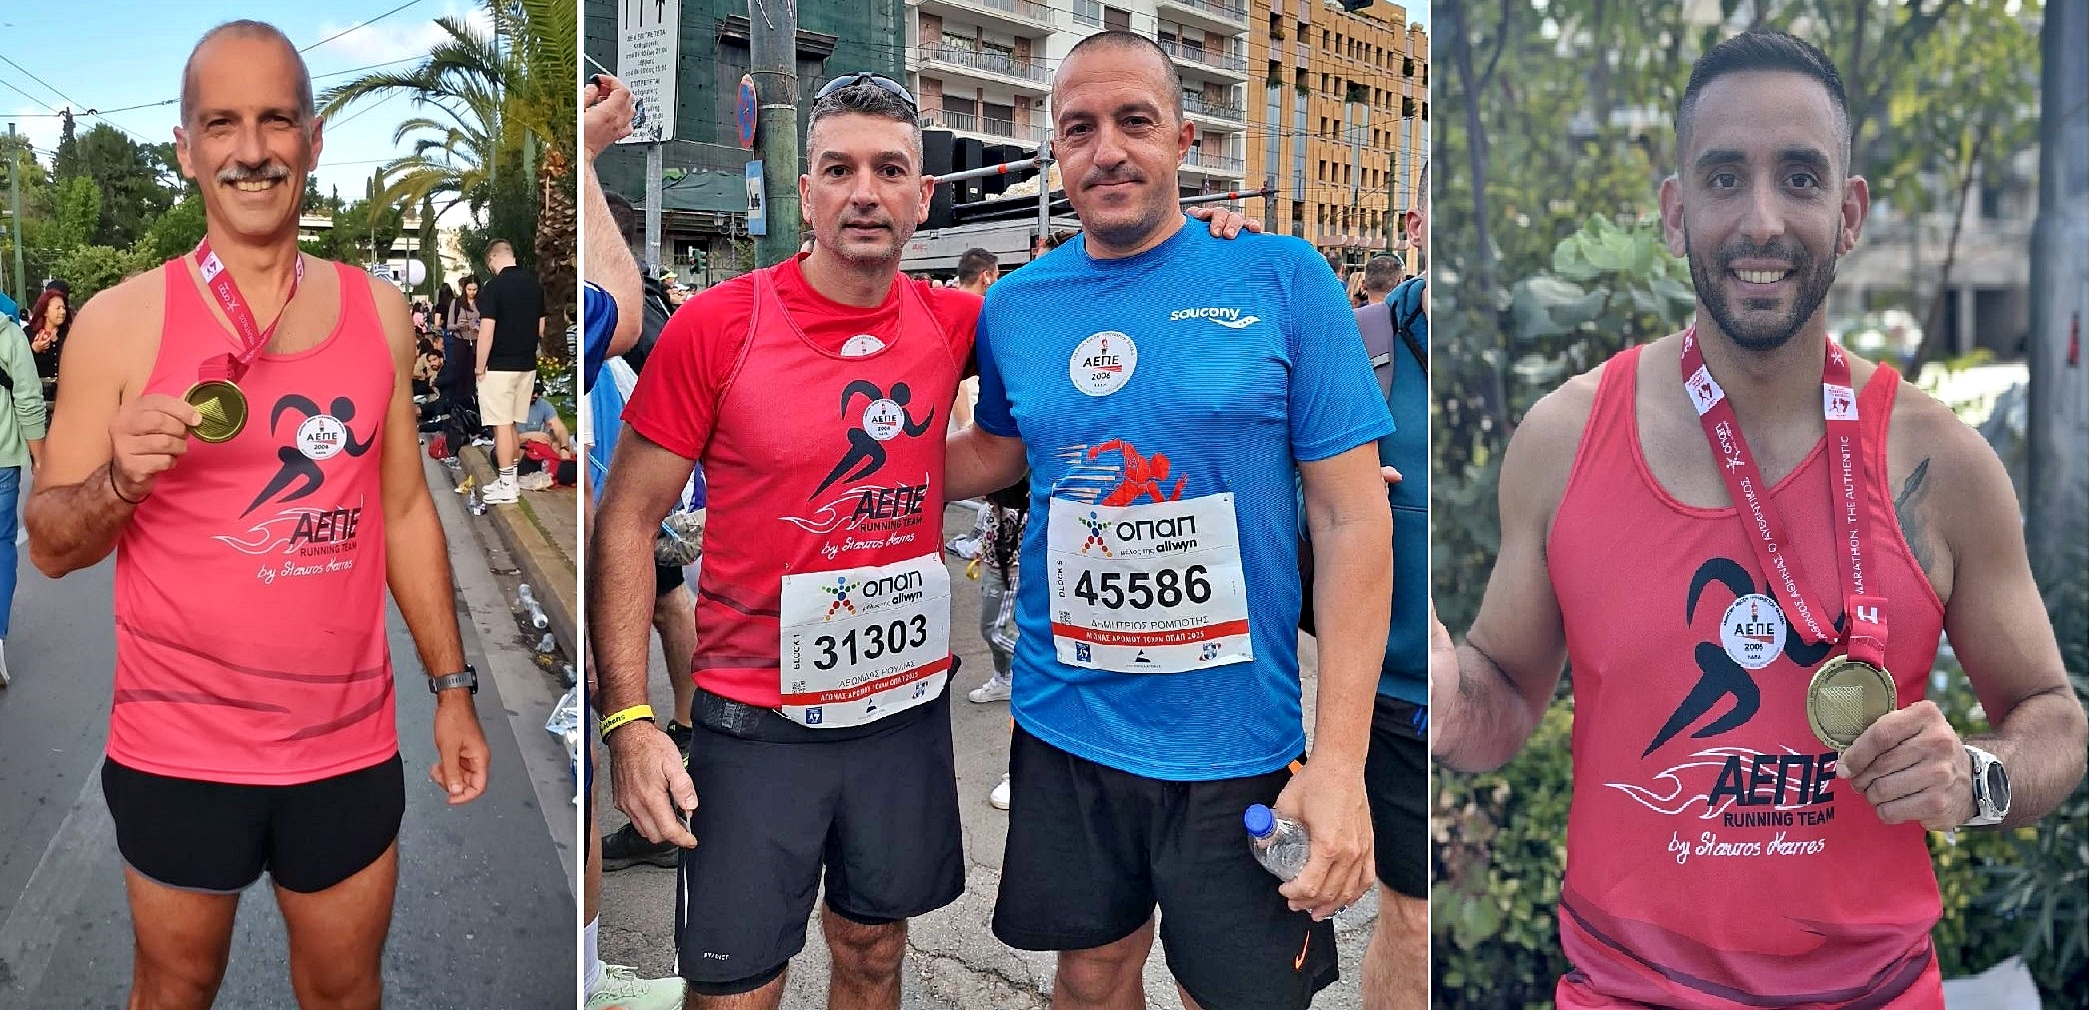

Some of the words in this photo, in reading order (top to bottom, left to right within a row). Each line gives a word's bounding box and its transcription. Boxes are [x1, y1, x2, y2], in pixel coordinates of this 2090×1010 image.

[1170, 307, 1241, 321] saucony
[1083, 355, 1119, 367] ΑΕΠΕ
[871, 415, 897, 423] ΑΕΠΕ
[307, 432, 338, 441] ΑΕΠΕ
[1839, 436, 1854, 500] AUTHENTIC
[851, 484, 927, 521] ΑΕΠΕ
[1847, 502, 1857, 525] THE
[289, 507, 361, 544] ΑΕΠΕ
[860, 519, 901, 533] RUNNING
[903, 517, 923, 528] TEAM
[300, 545, 340, 557] RUNNING
[342, 541, 357, 552] TEAM
[822, 541, 839, 560] by
[1156, 539, 1198, 552] allwyn
[257, 564, 276, 584] by
[1074, 564, 1212, 610] 45586
[891, 591, 923, 605] allwyn
[1150, 615, 1210, 630] ΡΟΜΠΟΤΗΣ
[1734, 623, 1775, 635] ΑΕΠΕ
[813, 614, 928, 670] 31303
[1706, 751, 1840, 807] ΑΕΠΕ
[1723, 811, 1794, 828] RUNNING
[1796, 806, 1835, 826] TEAM
[1668, 831, 1691, 864] by
